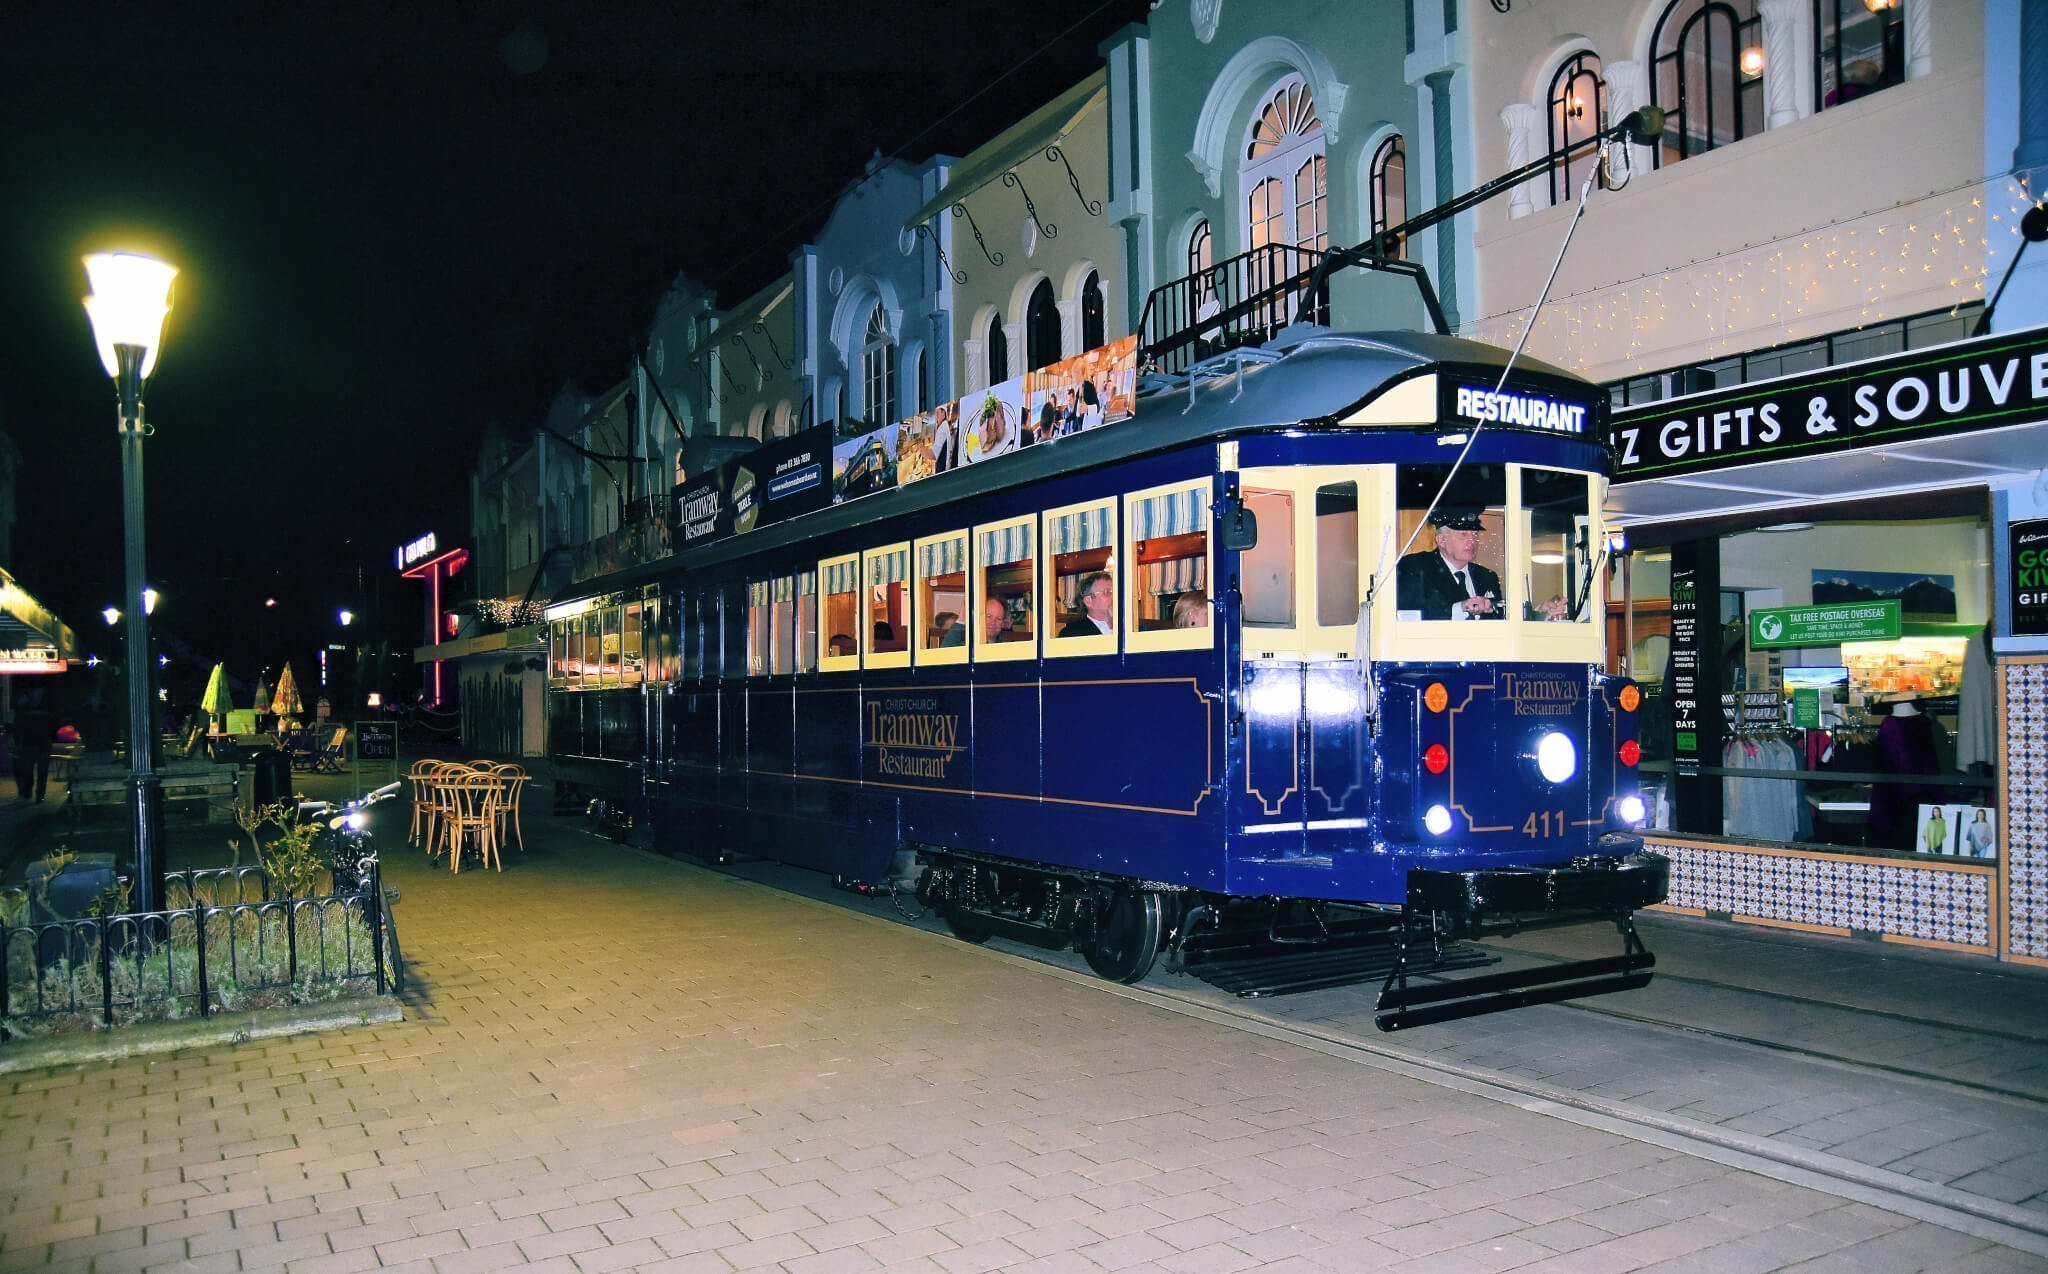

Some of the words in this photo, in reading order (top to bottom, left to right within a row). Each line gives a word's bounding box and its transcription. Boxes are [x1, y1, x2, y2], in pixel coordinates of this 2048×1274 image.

[1457, 388, 1585, 433] RESTAURANT
[1610, 428, 1640, 466] Z
[1659, 403, 1781, 458] GIFTS
[1805, 396, 1837, 436] &
[679, 490, 719, 525] Tramway
[737, 494, 752, 513] TABLE
[685, 518, 715, 541] Restaurant
[1672, 590, 1696, 601] KIWI
[1672, 603, 1696, 611] GIFTS
[1789, 613, 1802, 623] TAX
[1802, 612, 1818, 622] FREE
[1819, 610, 1849, 621] POSTAGE
[1851, 608, 1885, 619] OVERSEAS
[1501, 673, 1581, 706] Tramway
[885, 699, 937, 711] CHRISTCHURCH
[1514, 699, 1572, 716] Restaurant
[1675, 700, 1696, 709] OPEN
[1682, 709, 1689, 719] 7
[866, 701, 959, 763] Tramway
[1675, 720, 1696, 728] DAYS
[879, 747, 946, 779] Restaurant
[1522, 810, 1564, 839] 411
